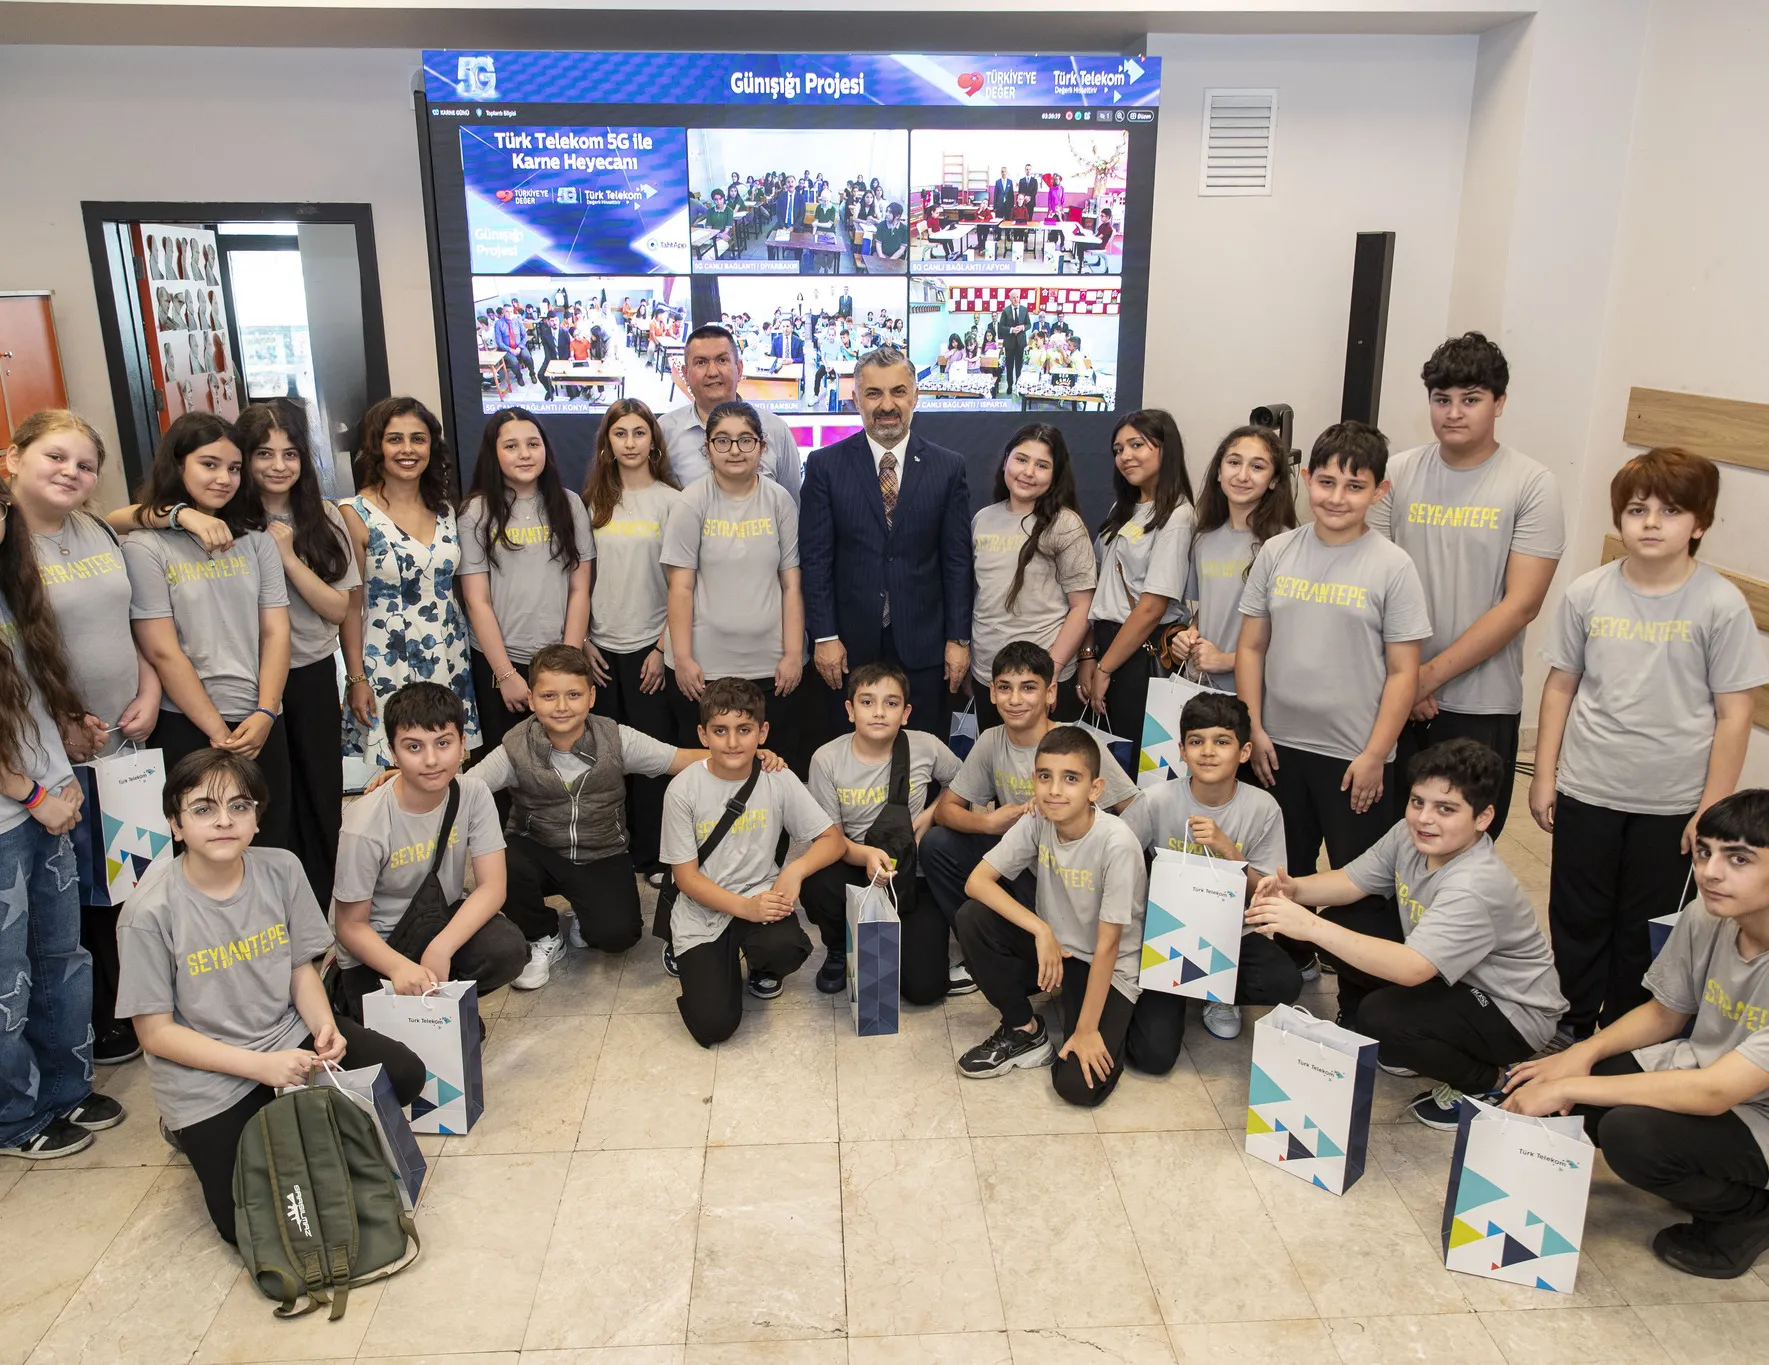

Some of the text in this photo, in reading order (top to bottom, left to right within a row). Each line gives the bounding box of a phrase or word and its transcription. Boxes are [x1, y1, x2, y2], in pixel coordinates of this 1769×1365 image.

[457, 56, 497, 97] 5G
[730, 71, 865, 99] Günışığı Projesi
[985, 69, 1037, 85] TÜRKİYE'YE
[1053, 69, 1125, 87] Türk Telekom
[985, 85, 1016, 100] DEĞER
[493, 132, 653, 150] Türk Telekom 5G ile
[512, 153, 638, 173] Karne Heyecanı
[584, 190, 643, 201] Türk Telekom
[986, 263, 1010, 271] AFYON
[485, 404, 495, 412] 5G
[562, 404, 588, 412] KONYA
[1407, 502, 1502, 530] SEYRANTEPE
[703, 517, 775, 539] SEYRANTEPE
[1274, 575, 1368, 609] SEYRANTEPE
[1519, 1148, 1567, 1168] Türk Telekom
